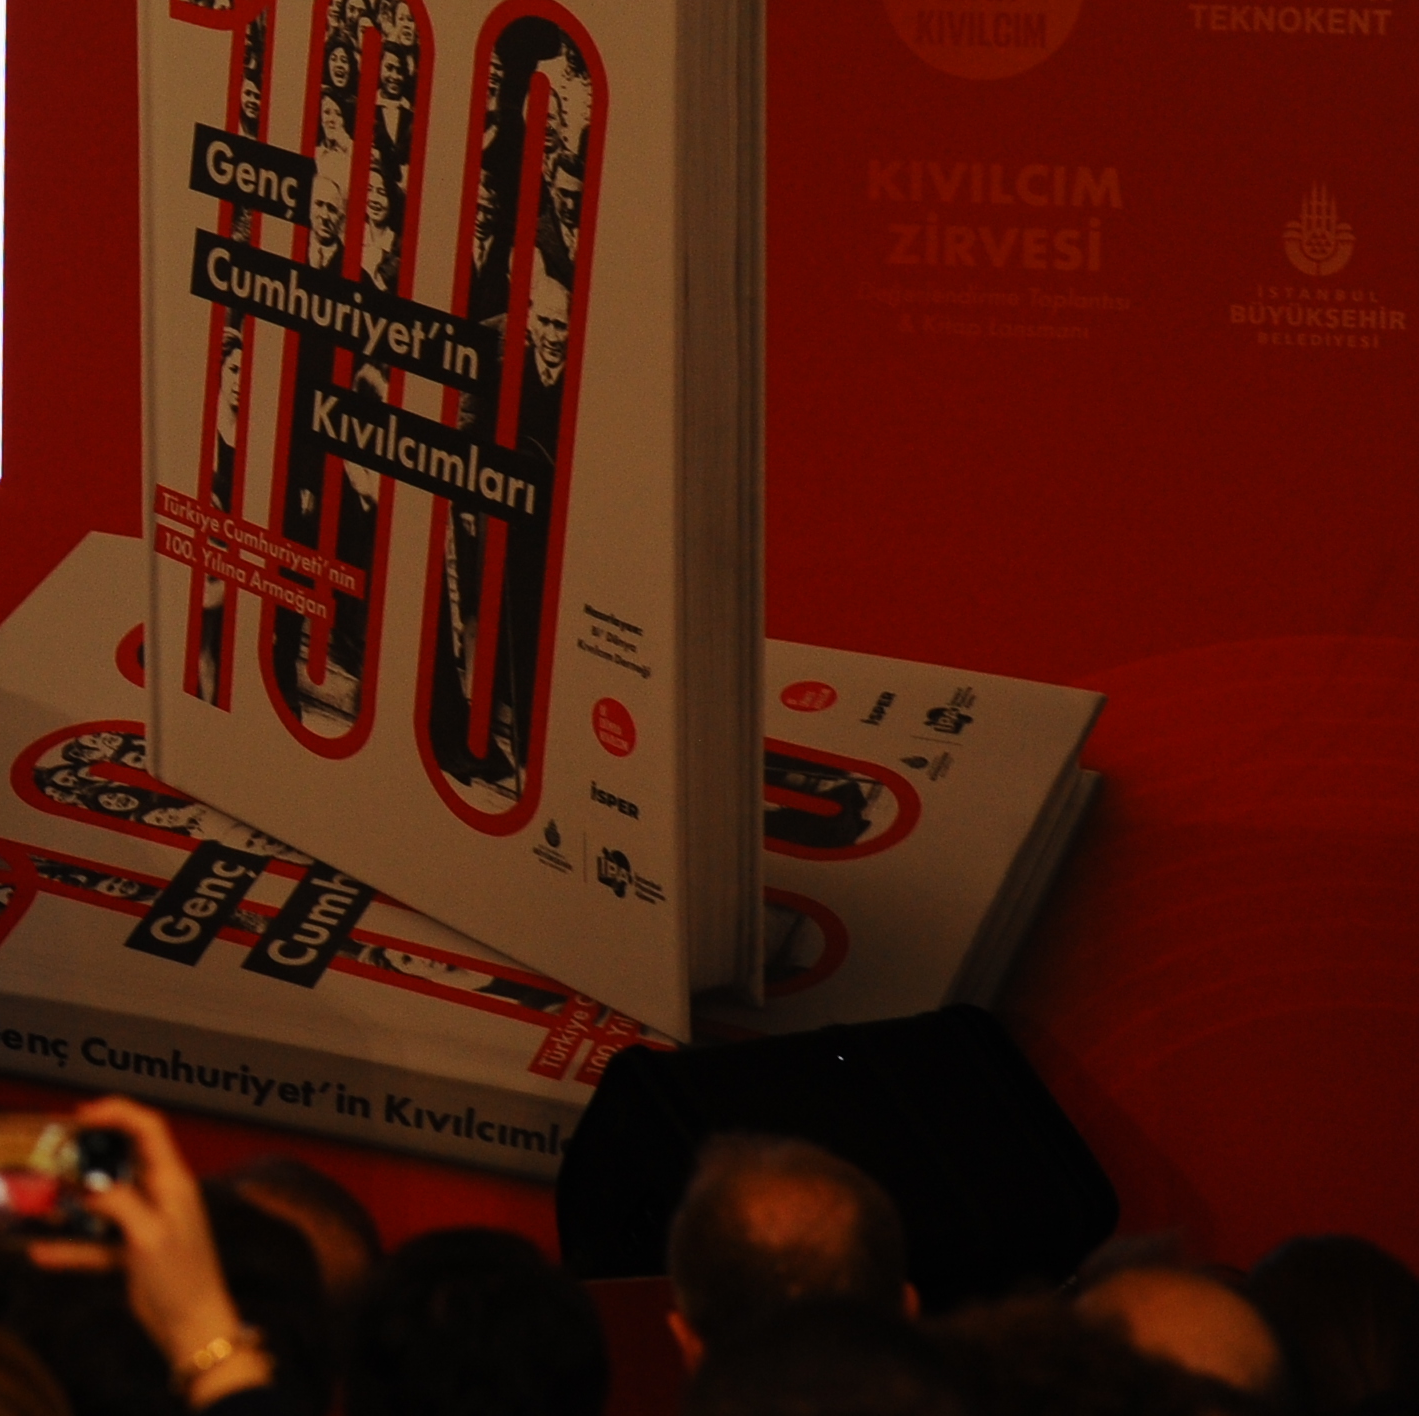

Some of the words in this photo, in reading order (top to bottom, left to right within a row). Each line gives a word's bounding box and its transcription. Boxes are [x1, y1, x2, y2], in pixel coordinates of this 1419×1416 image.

[915, 9, 1046, 49] KIVILCIM
[1188, 3, 1392, 36] TEKNOKENT
[205, 139, 299, 220] Genç
[867, 159, 1123, 209] KIVILCIM
[886, 210, 1101, 272] ZİRVESİ
[206, 246, 479, 381] Cumhuriyet'in
[1229, 301, 1407, 331] BÜYÜKŞEHİR
[1257, 284, 1380, 304] İSTANBUL
[1257, 331, 1380, 349] BELEDİYESİ
[311, 391, 536, 515] Kıvılcımları
[163, 492, 220, 533] Türkiye
[165, 531, 197, 563] 100.
[202, 547, 247, 584] Yılına
[250, 570, 327, 619] Armağan
[150, 860, 257, 945] Genç
[538, 1010, 590, 1069] Türkiye
[81, 1036, 371, 1120] Cumhuriyet'in
